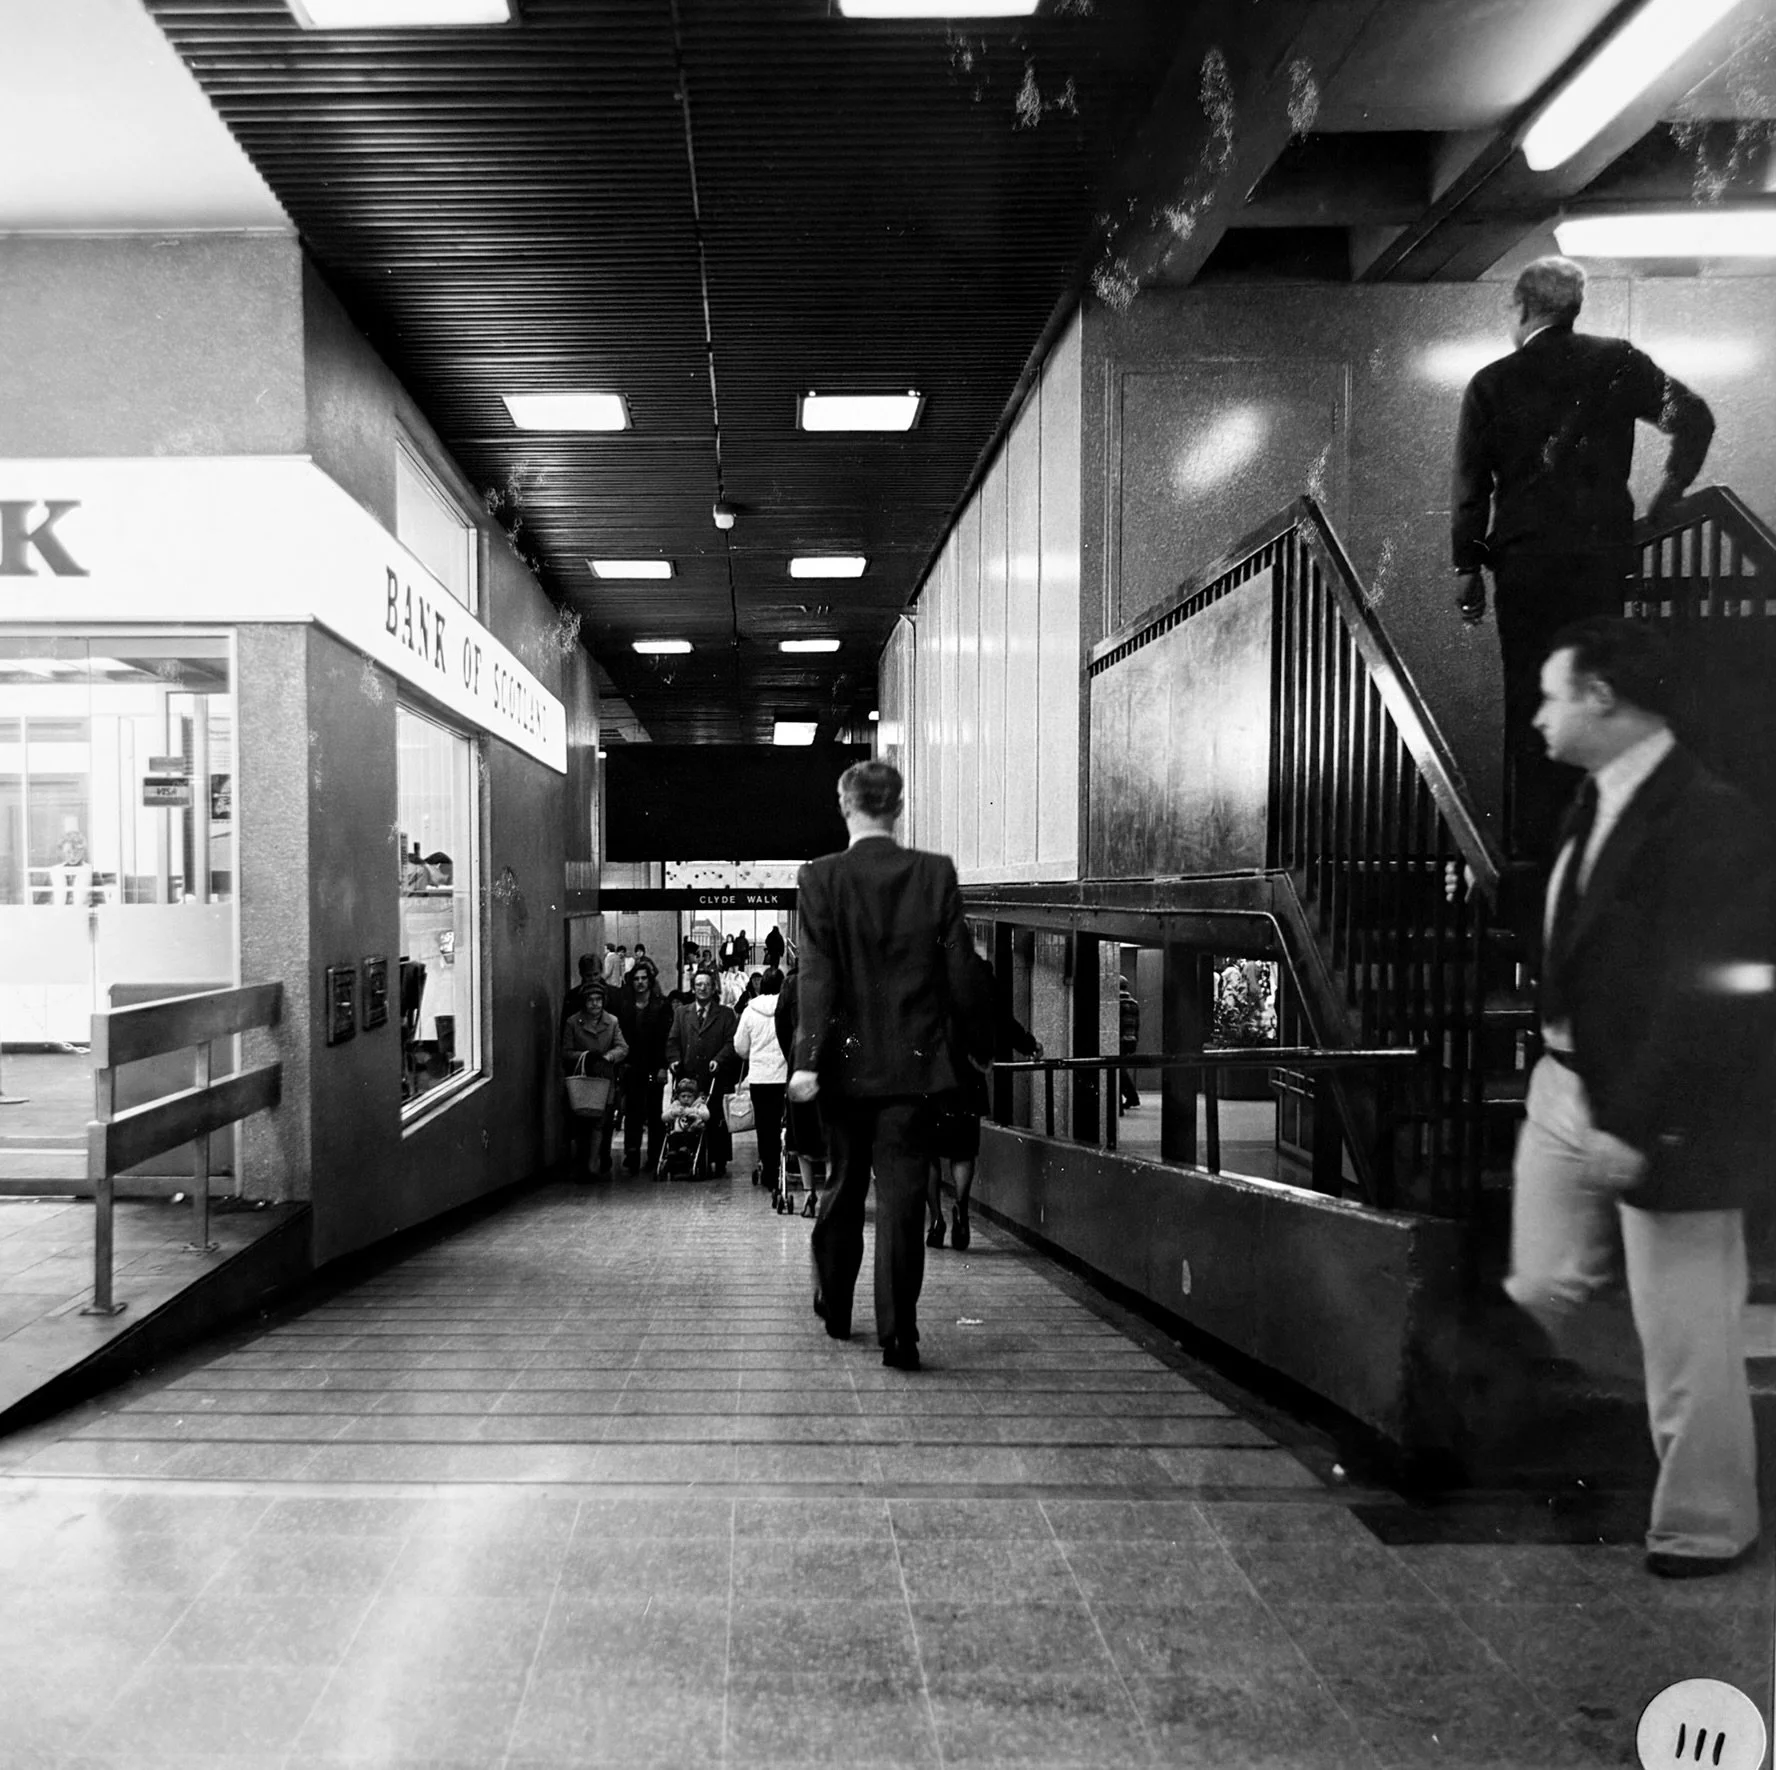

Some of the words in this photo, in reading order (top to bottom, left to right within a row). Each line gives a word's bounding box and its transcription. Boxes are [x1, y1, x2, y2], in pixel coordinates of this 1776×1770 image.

[0, 499, 91, 577] K
[386, 564, 446, 674] BANK
[463, 636, 482, 696] OF
[699, 895, 736, 904] CLYDE
[746, 895, 779, 904] WALK
[1675, 1722, 1726, 1766] 111
